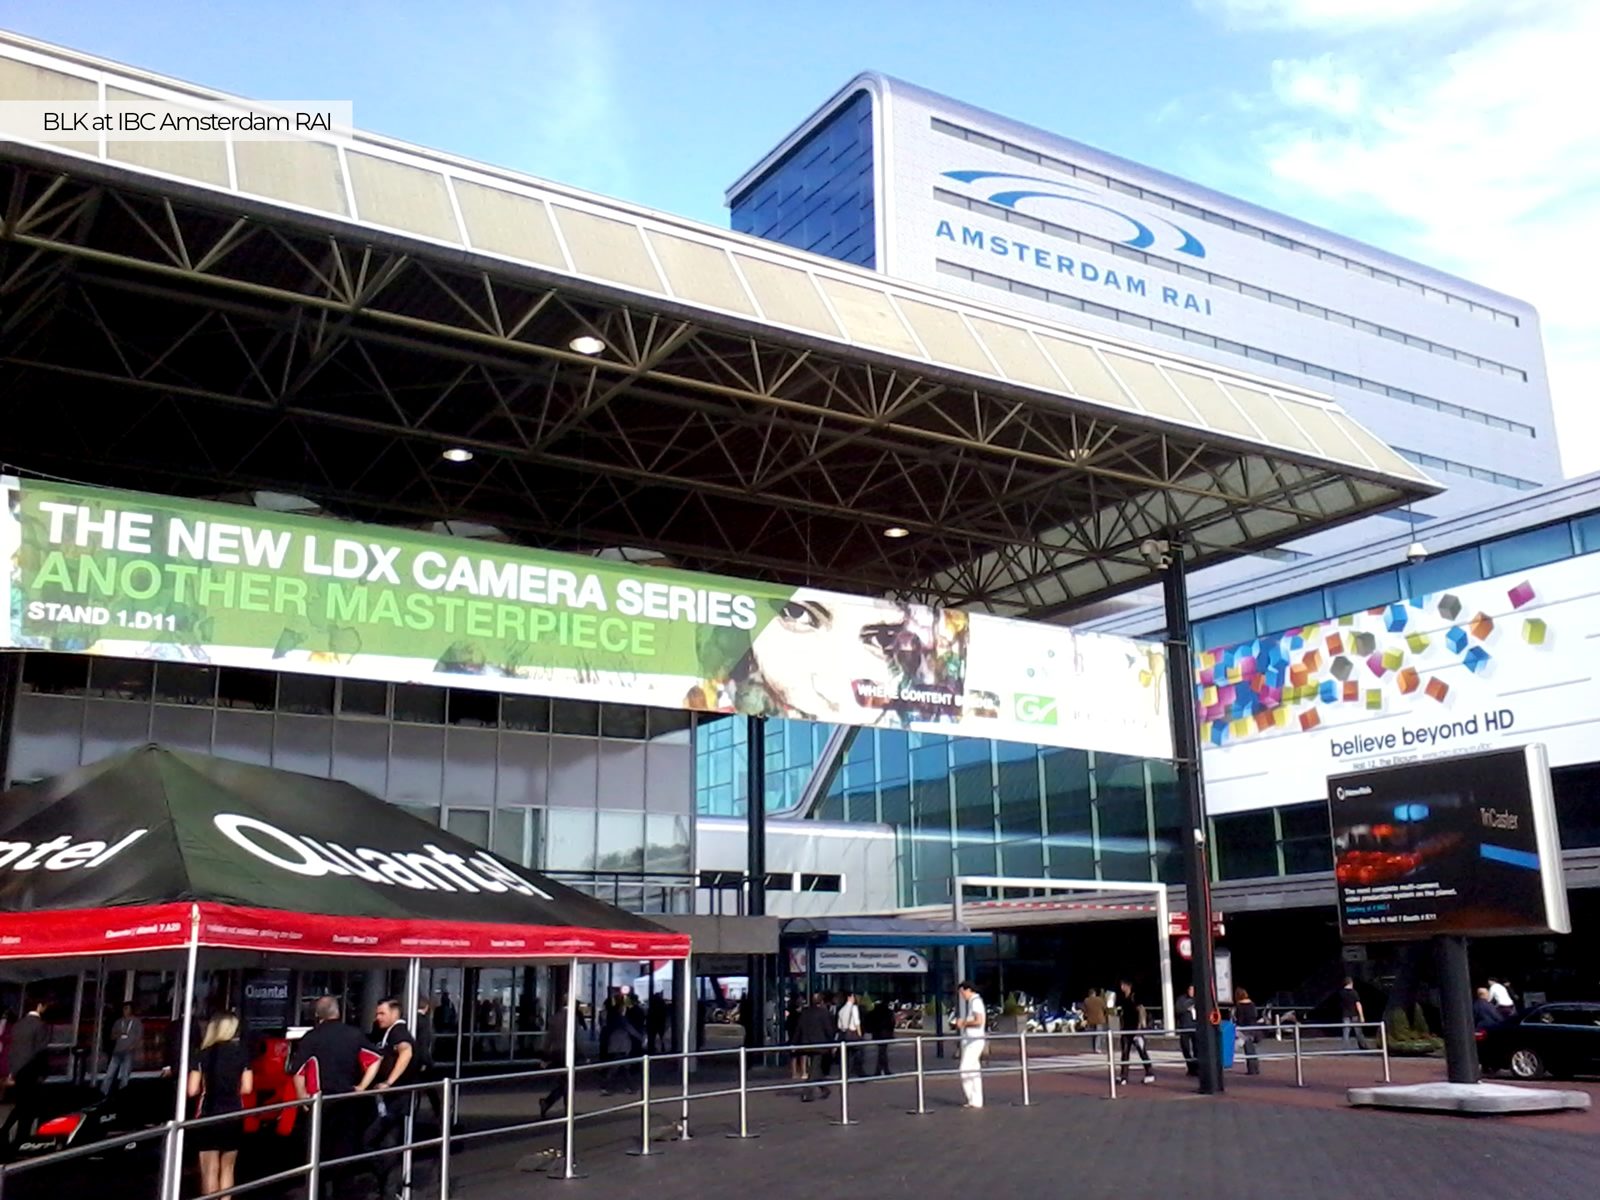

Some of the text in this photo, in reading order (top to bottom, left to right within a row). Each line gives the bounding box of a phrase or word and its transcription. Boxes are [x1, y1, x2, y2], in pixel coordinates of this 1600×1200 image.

[936, 220, 1212, 316] AMSTERDAM RAI
[39, 501, 757, 630] THE NEW LDX CAMERA SERIES
[27, 602, 176, 632] STAND 1.D11
[31, 552, 656, 656] ANOTHER MASTERPIECE
[858, 684, 899, 699] WHERE
[901, 689, 952, 705] CONTENT
[1331, 732, 1397, 757] believe
[1402, 715, 1478, 746] beyond
[1484, 709, 1515, 732] HD
[213, 813, 554, 900] Quantel
[245, 984, 288, 998] Quantel
